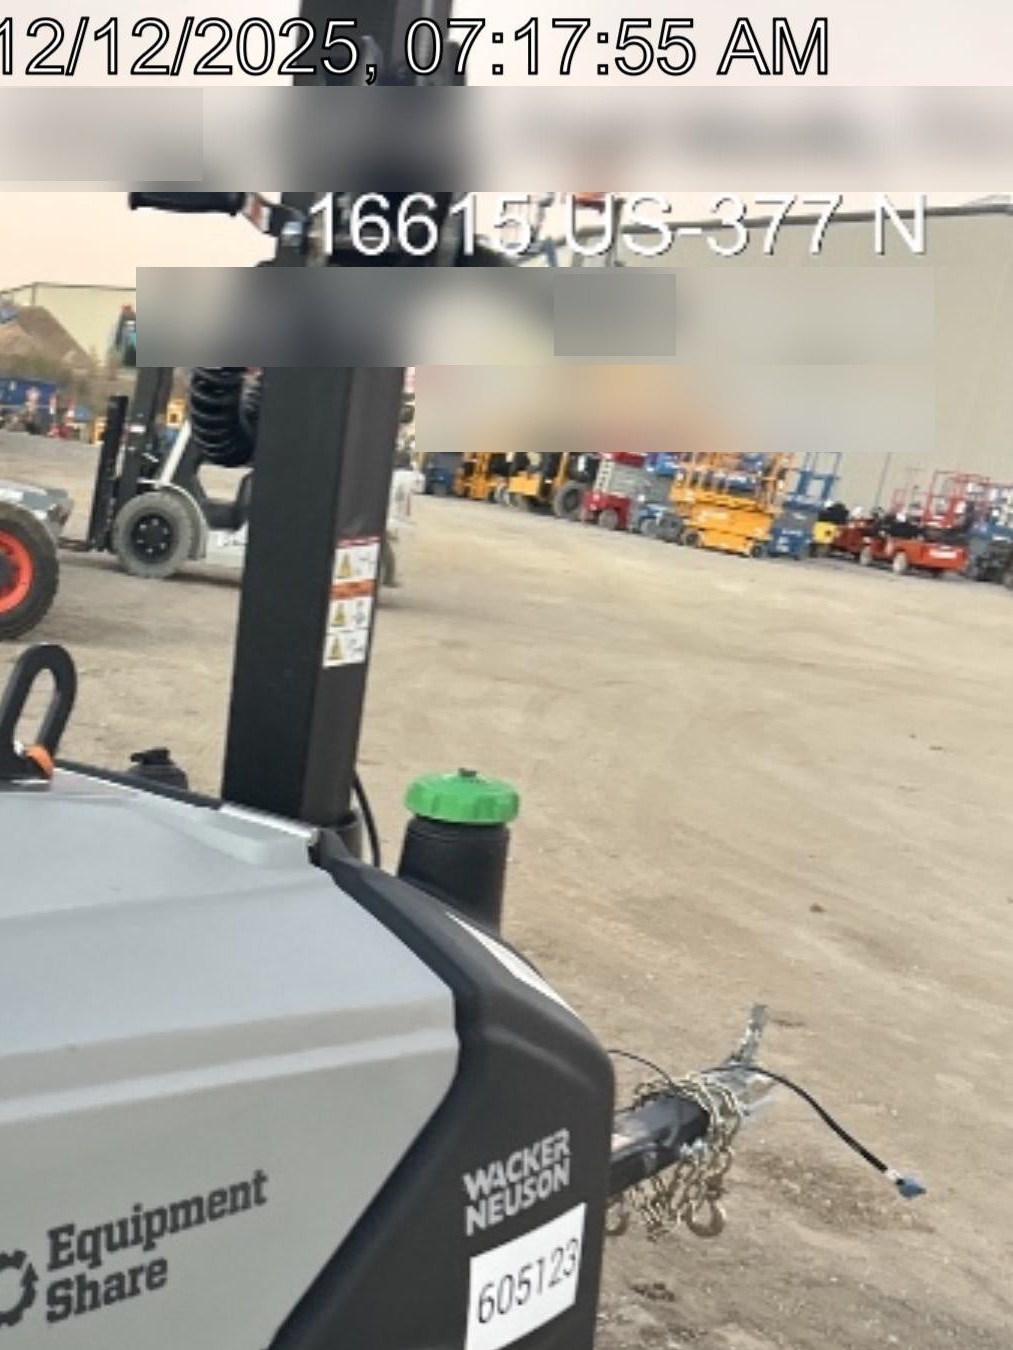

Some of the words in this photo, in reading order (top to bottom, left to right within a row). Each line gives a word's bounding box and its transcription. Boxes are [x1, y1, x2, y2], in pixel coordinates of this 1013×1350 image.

[462, 1127, 571, 1201] WACKER
[465, 1156, 571, 1237] NEUSON
[47, 1169, 268, 1272] Equipment
[45, 1256, 168, 1324] Share
[477, 1238, 579, 1325] 605123
